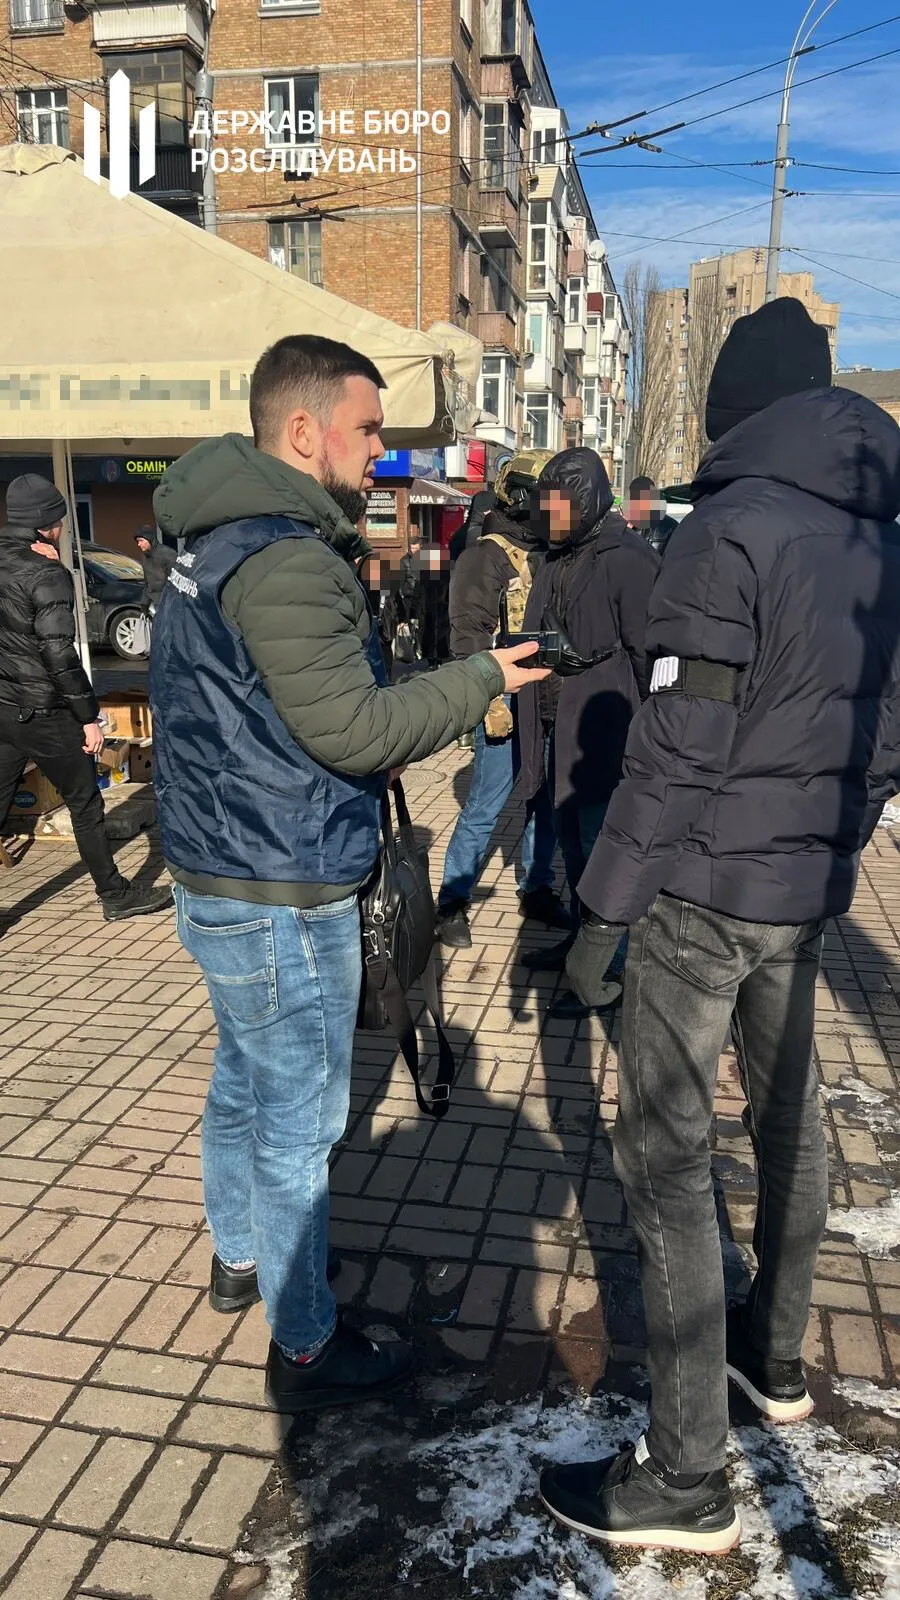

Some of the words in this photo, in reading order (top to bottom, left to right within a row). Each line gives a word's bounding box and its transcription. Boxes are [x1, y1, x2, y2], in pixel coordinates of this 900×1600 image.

[126, 461, 167, 473] ОБМІН
[409, 495, 434, 504] КАВА
[695, 1502, 717, 1517] GUESS
